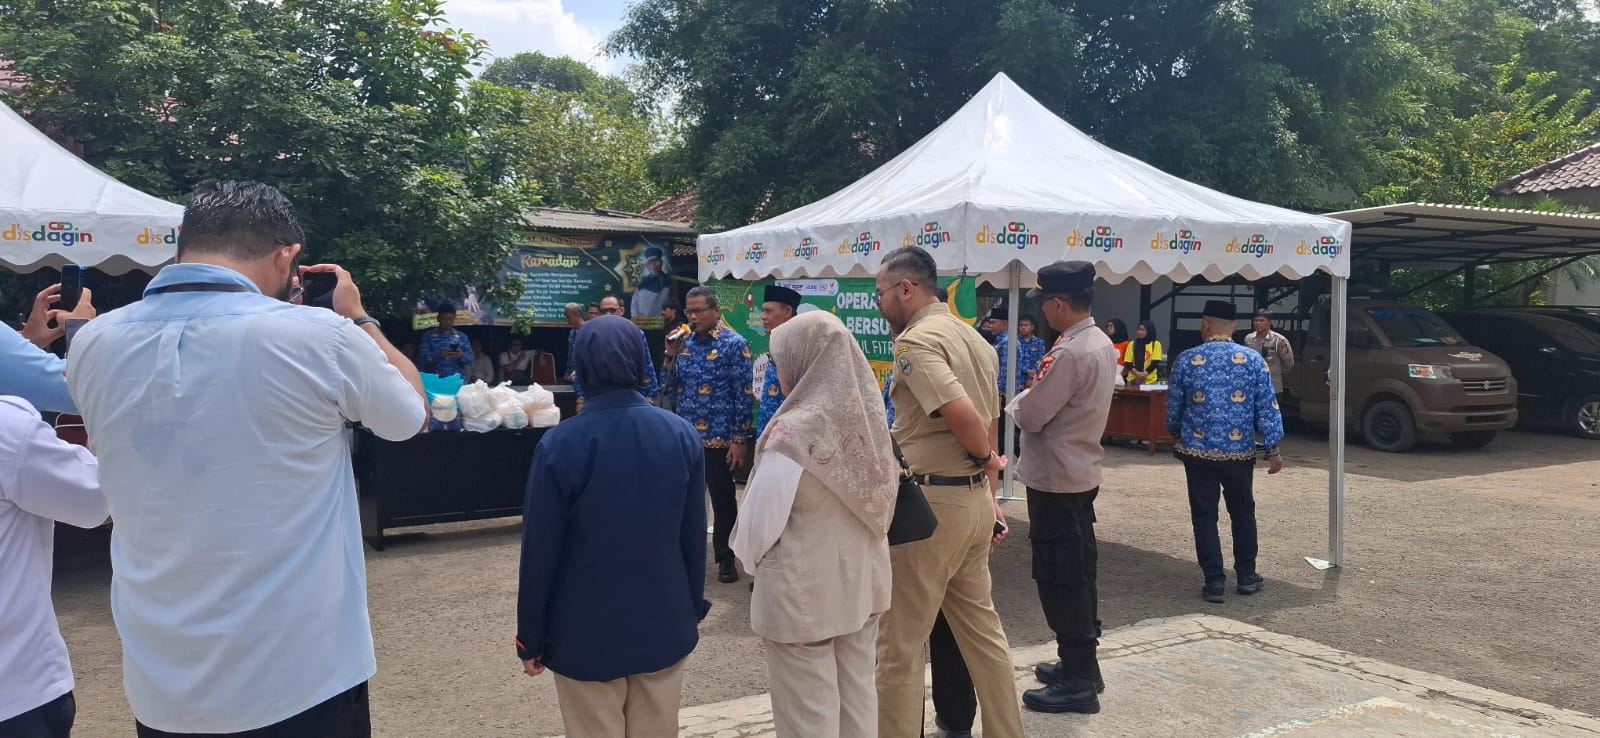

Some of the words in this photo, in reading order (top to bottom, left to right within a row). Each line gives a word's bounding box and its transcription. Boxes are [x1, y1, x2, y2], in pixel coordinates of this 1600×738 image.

[2, 223, 93, 246] disdagin
[136, 227, 176, 245] disd
[838, 233, 880, 256] disdagin
[902, 225, 950, 248] disdagin
[976, 222, 1039, 249] disdagin
[1067, 226, 1123, 252] disdagin
[1151, 229, 1201, 254] disdagin
[784, 239, 818, 260] disdagin
[1226, 235, 1274, 258] disdagin
[521, 253, 580, 269] Ramadan
[836, 292, 880, 310] OPERA
[846, 316, 890, 336] BERSU
[872, 340, 894, 355] FITR
